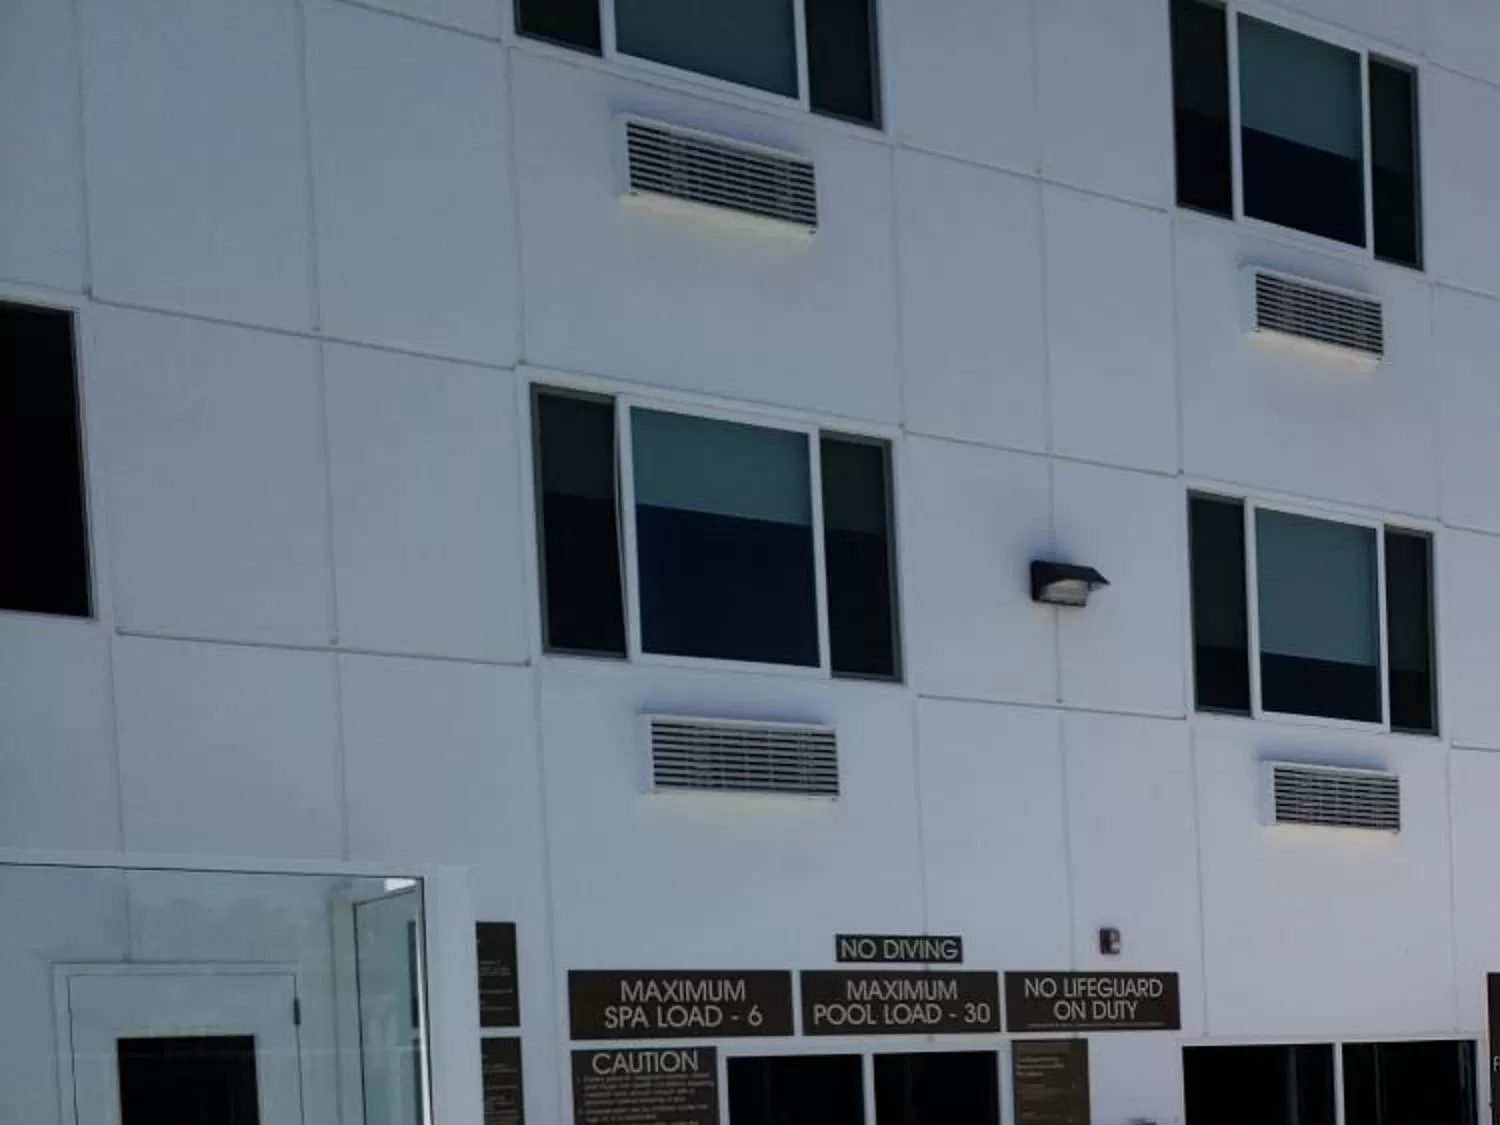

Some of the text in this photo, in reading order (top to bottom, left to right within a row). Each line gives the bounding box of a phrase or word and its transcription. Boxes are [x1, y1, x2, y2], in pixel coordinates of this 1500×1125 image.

[841, 938, 959, 960] NO DIVING
[620, 979, 746, 1003] MAXIMUM
[847, 979, 958, 1001] MAXIMUM
[1024, 977, 1163, 998] NO LIFEGUARD
[604, 1005, 650, 1029] SPA
[656, 1003, 723, 1028] LOAD
[747, 1004, 763, 1027] 6
[813, 1003, 877, 1026] POOL
[884, 1003, 943, 1025] LOAD
[963, 1002, 991, 1024] 30
[1053, 999, 1138, 1021] ON DUTY
[591, 1050, 700, 1075] CAUTION
